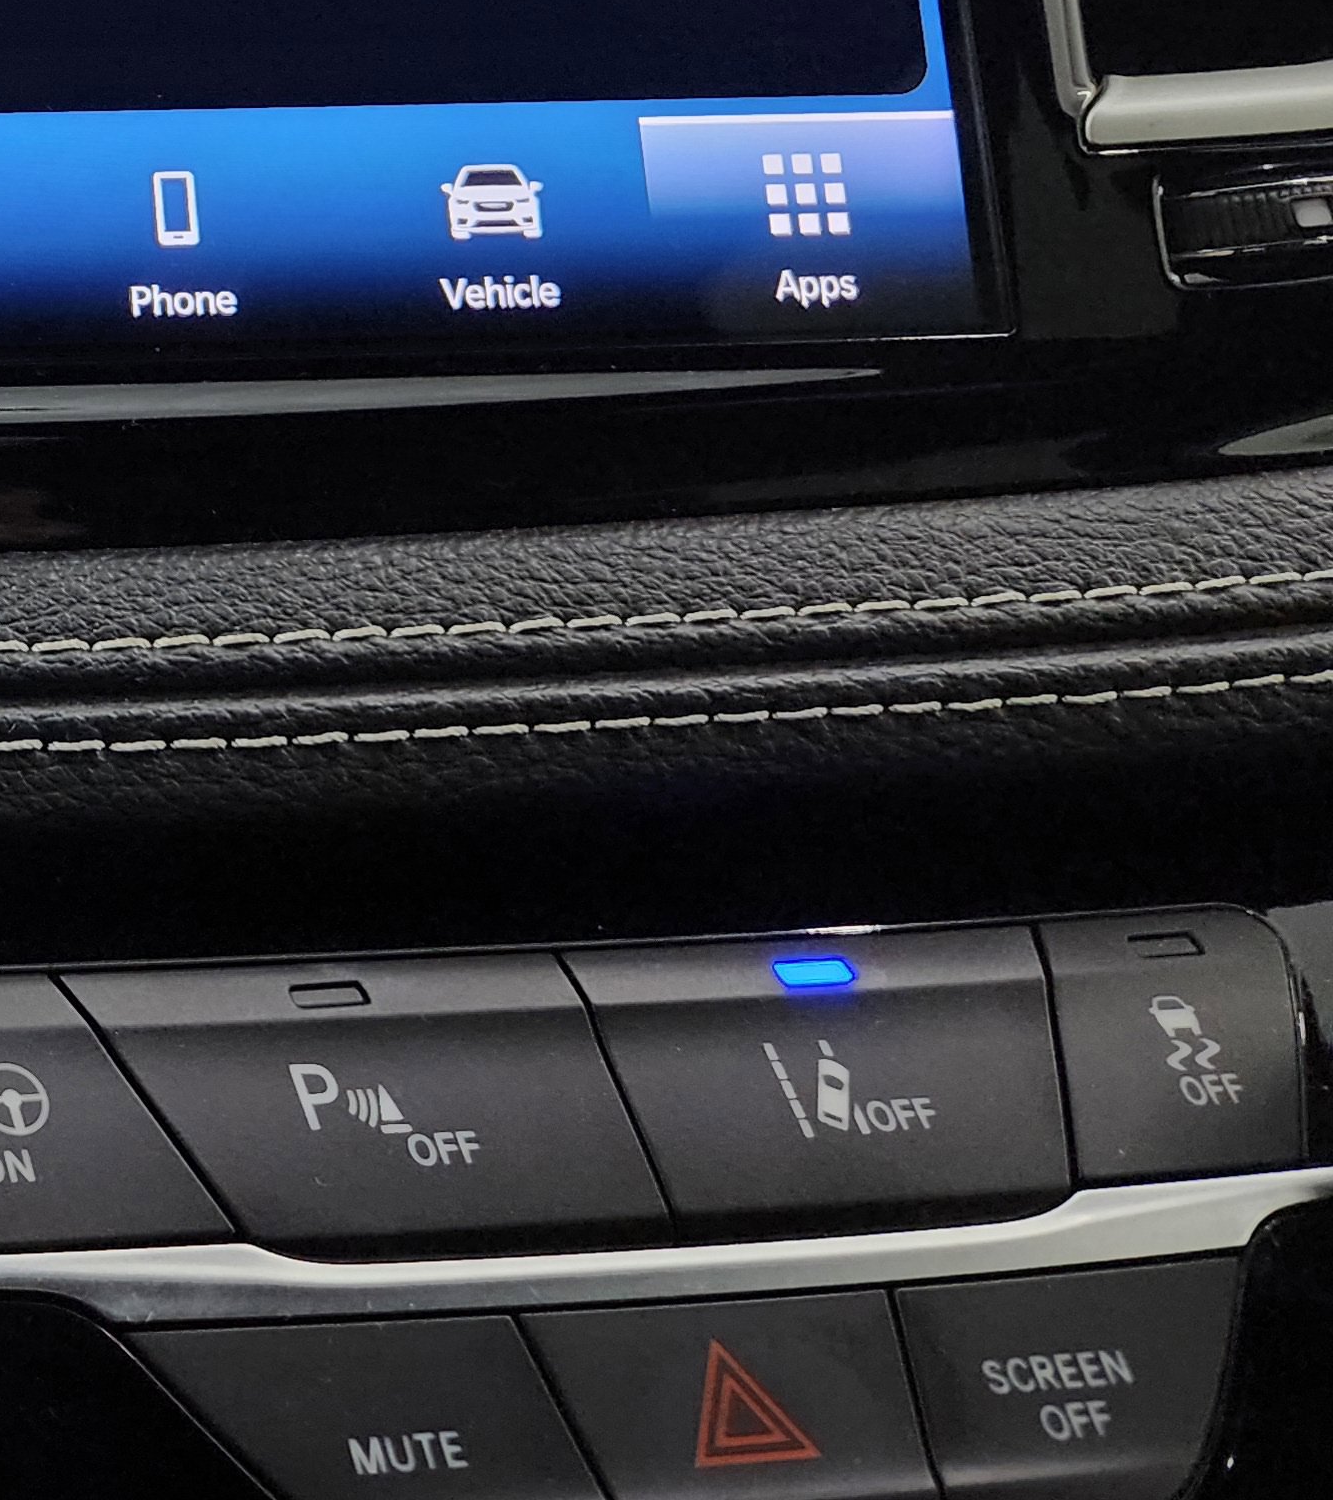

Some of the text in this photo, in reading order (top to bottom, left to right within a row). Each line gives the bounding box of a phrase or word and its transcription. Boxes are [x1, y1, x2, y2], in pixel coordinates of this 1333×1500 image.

[128, 283, 239, 319] Phone
[438, 273, 562, 311] Vehicle
[774, 268, 859, 310] Apps
[1178, 1072, 1244, 1107] OFF
[869, 1096, 937, 1134] OFF
[405, 1130, 482, 1168] OFF
[980, 1349, 1134, 1396] SCREEN
[1039, 1399, 1112, 1442] OFF
[347, 1430, 470, 1476] MUTE
